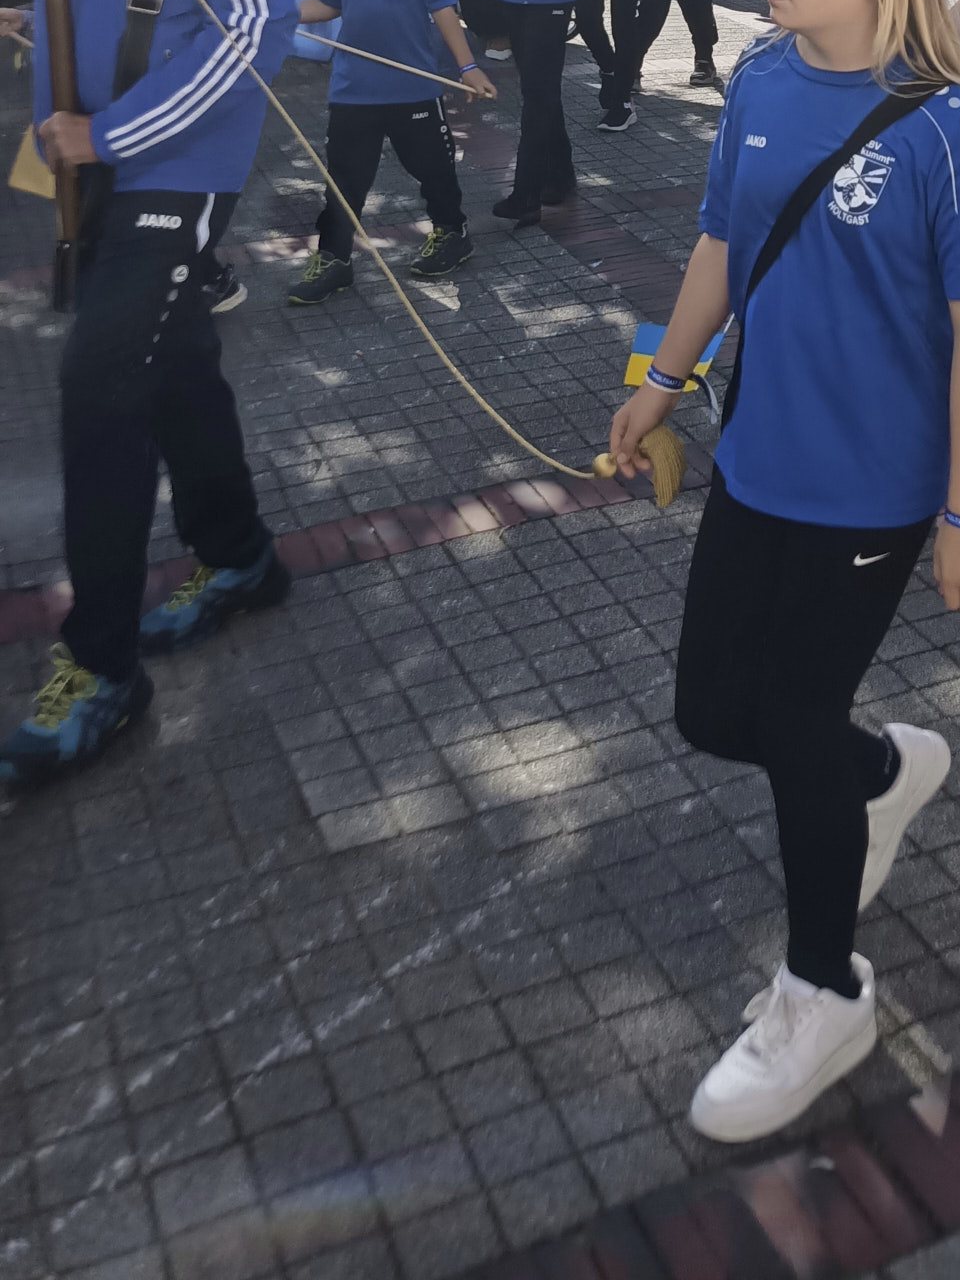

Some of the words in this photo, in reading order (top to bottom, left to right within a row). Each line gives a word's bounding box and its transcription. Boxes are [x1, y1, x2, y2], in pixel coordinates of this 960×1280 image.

[745, 134, 767, 148] JAKO
[865, 139, 883, 151] BV
[827, 200, 870, 226] HOLTGAST
[135, 213, 183, 230] JAKO
